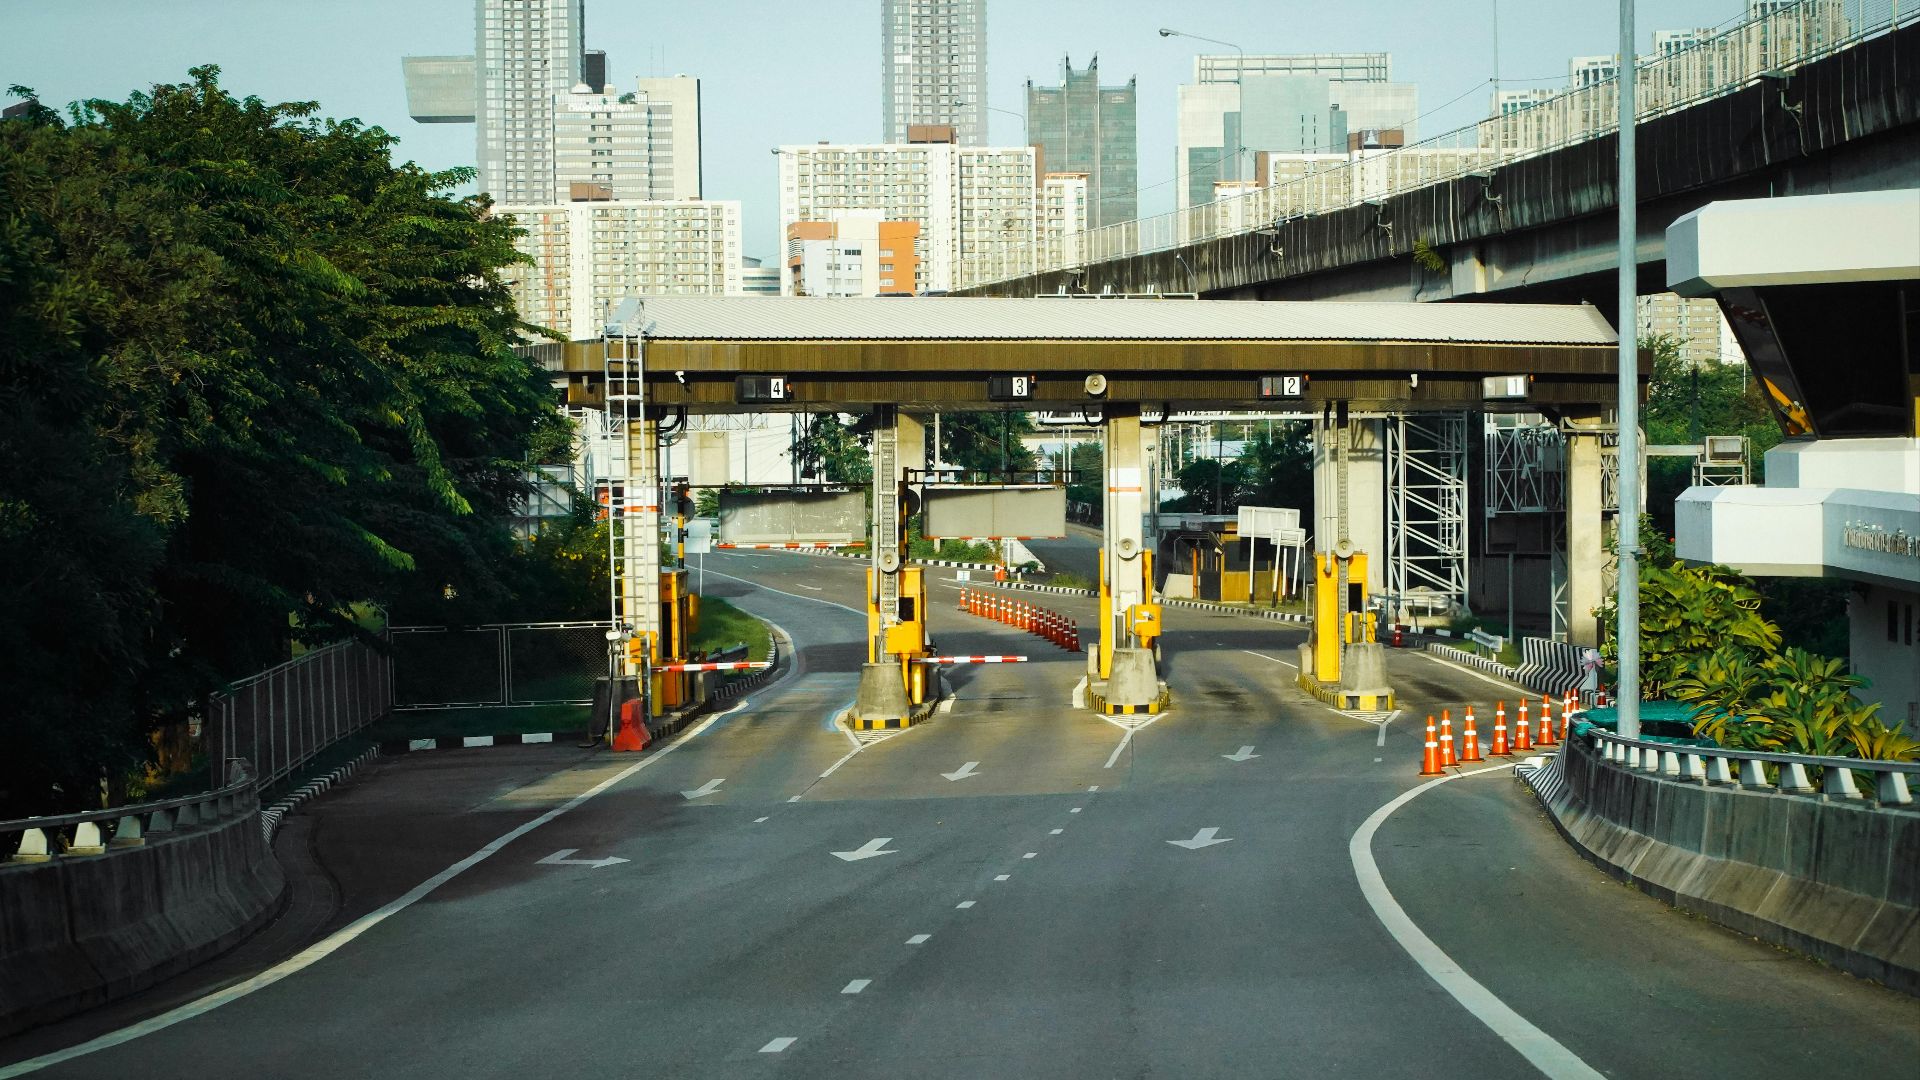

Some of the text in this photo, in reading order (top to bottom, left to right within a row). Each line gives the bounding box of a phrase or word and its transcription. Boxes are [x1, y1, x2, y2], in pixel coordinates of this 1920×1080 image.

[773, 381, 780, 395] 4
[1016, 378, 1023, 394] 3
[1288, 377, 1296, 394] 2
